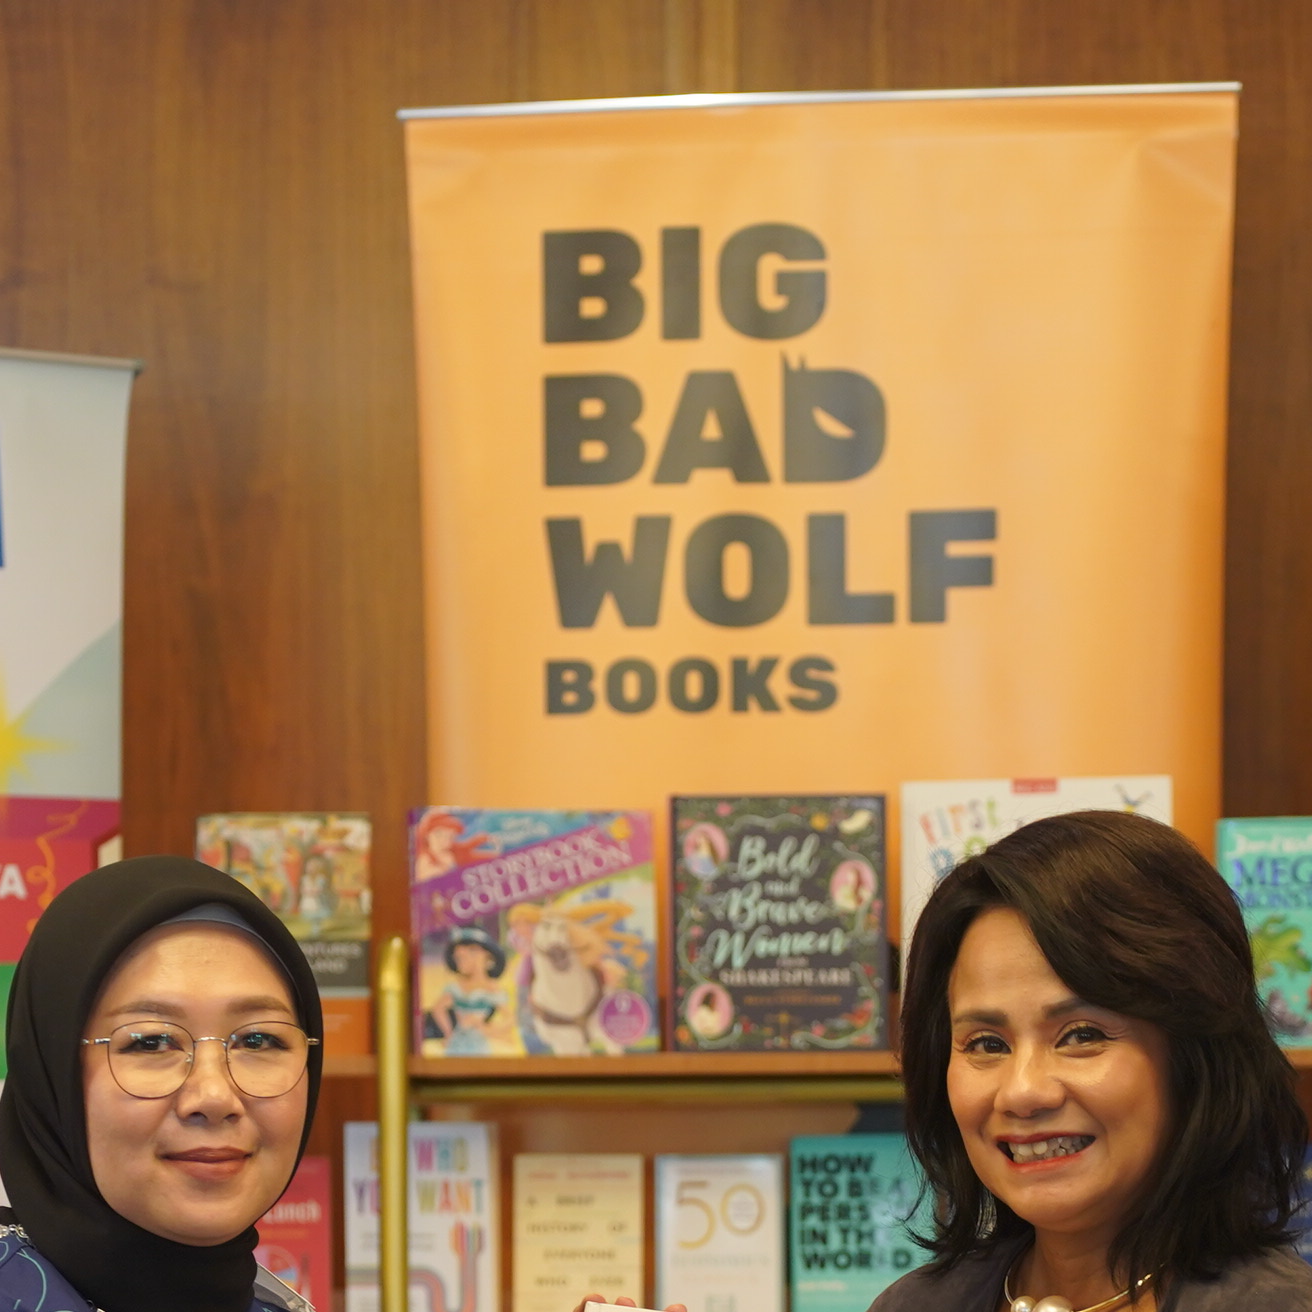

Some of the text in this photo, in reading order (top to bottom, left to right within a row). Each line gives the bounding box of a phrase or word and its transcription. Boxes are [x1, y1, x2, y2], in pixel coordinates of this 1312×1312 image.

[541, 221, 828, 346] BIG
[542, 350, 888, 487] BAD
[543, 508, 998, 630] WOLF
[544, 655, 839, 717] BOOKS
[451, 841, 634, 919] COLLECTION
[461, 825, 605, 887] STORYBOOK
[737, 832, 821, 881] Bold
[716, 880, 830, 932] Brave
[700, 925, 848, 970] Women
[414, 1136, 469, 1173] WHO
[798, 1154, 874, 1173] HOW
[416, 1178, 485, 1215] WANT
[801, 1177, 839, 1198] TO
[675, 1180, 767, 1251] 50
[800, 1227, 828, 1246] IN
